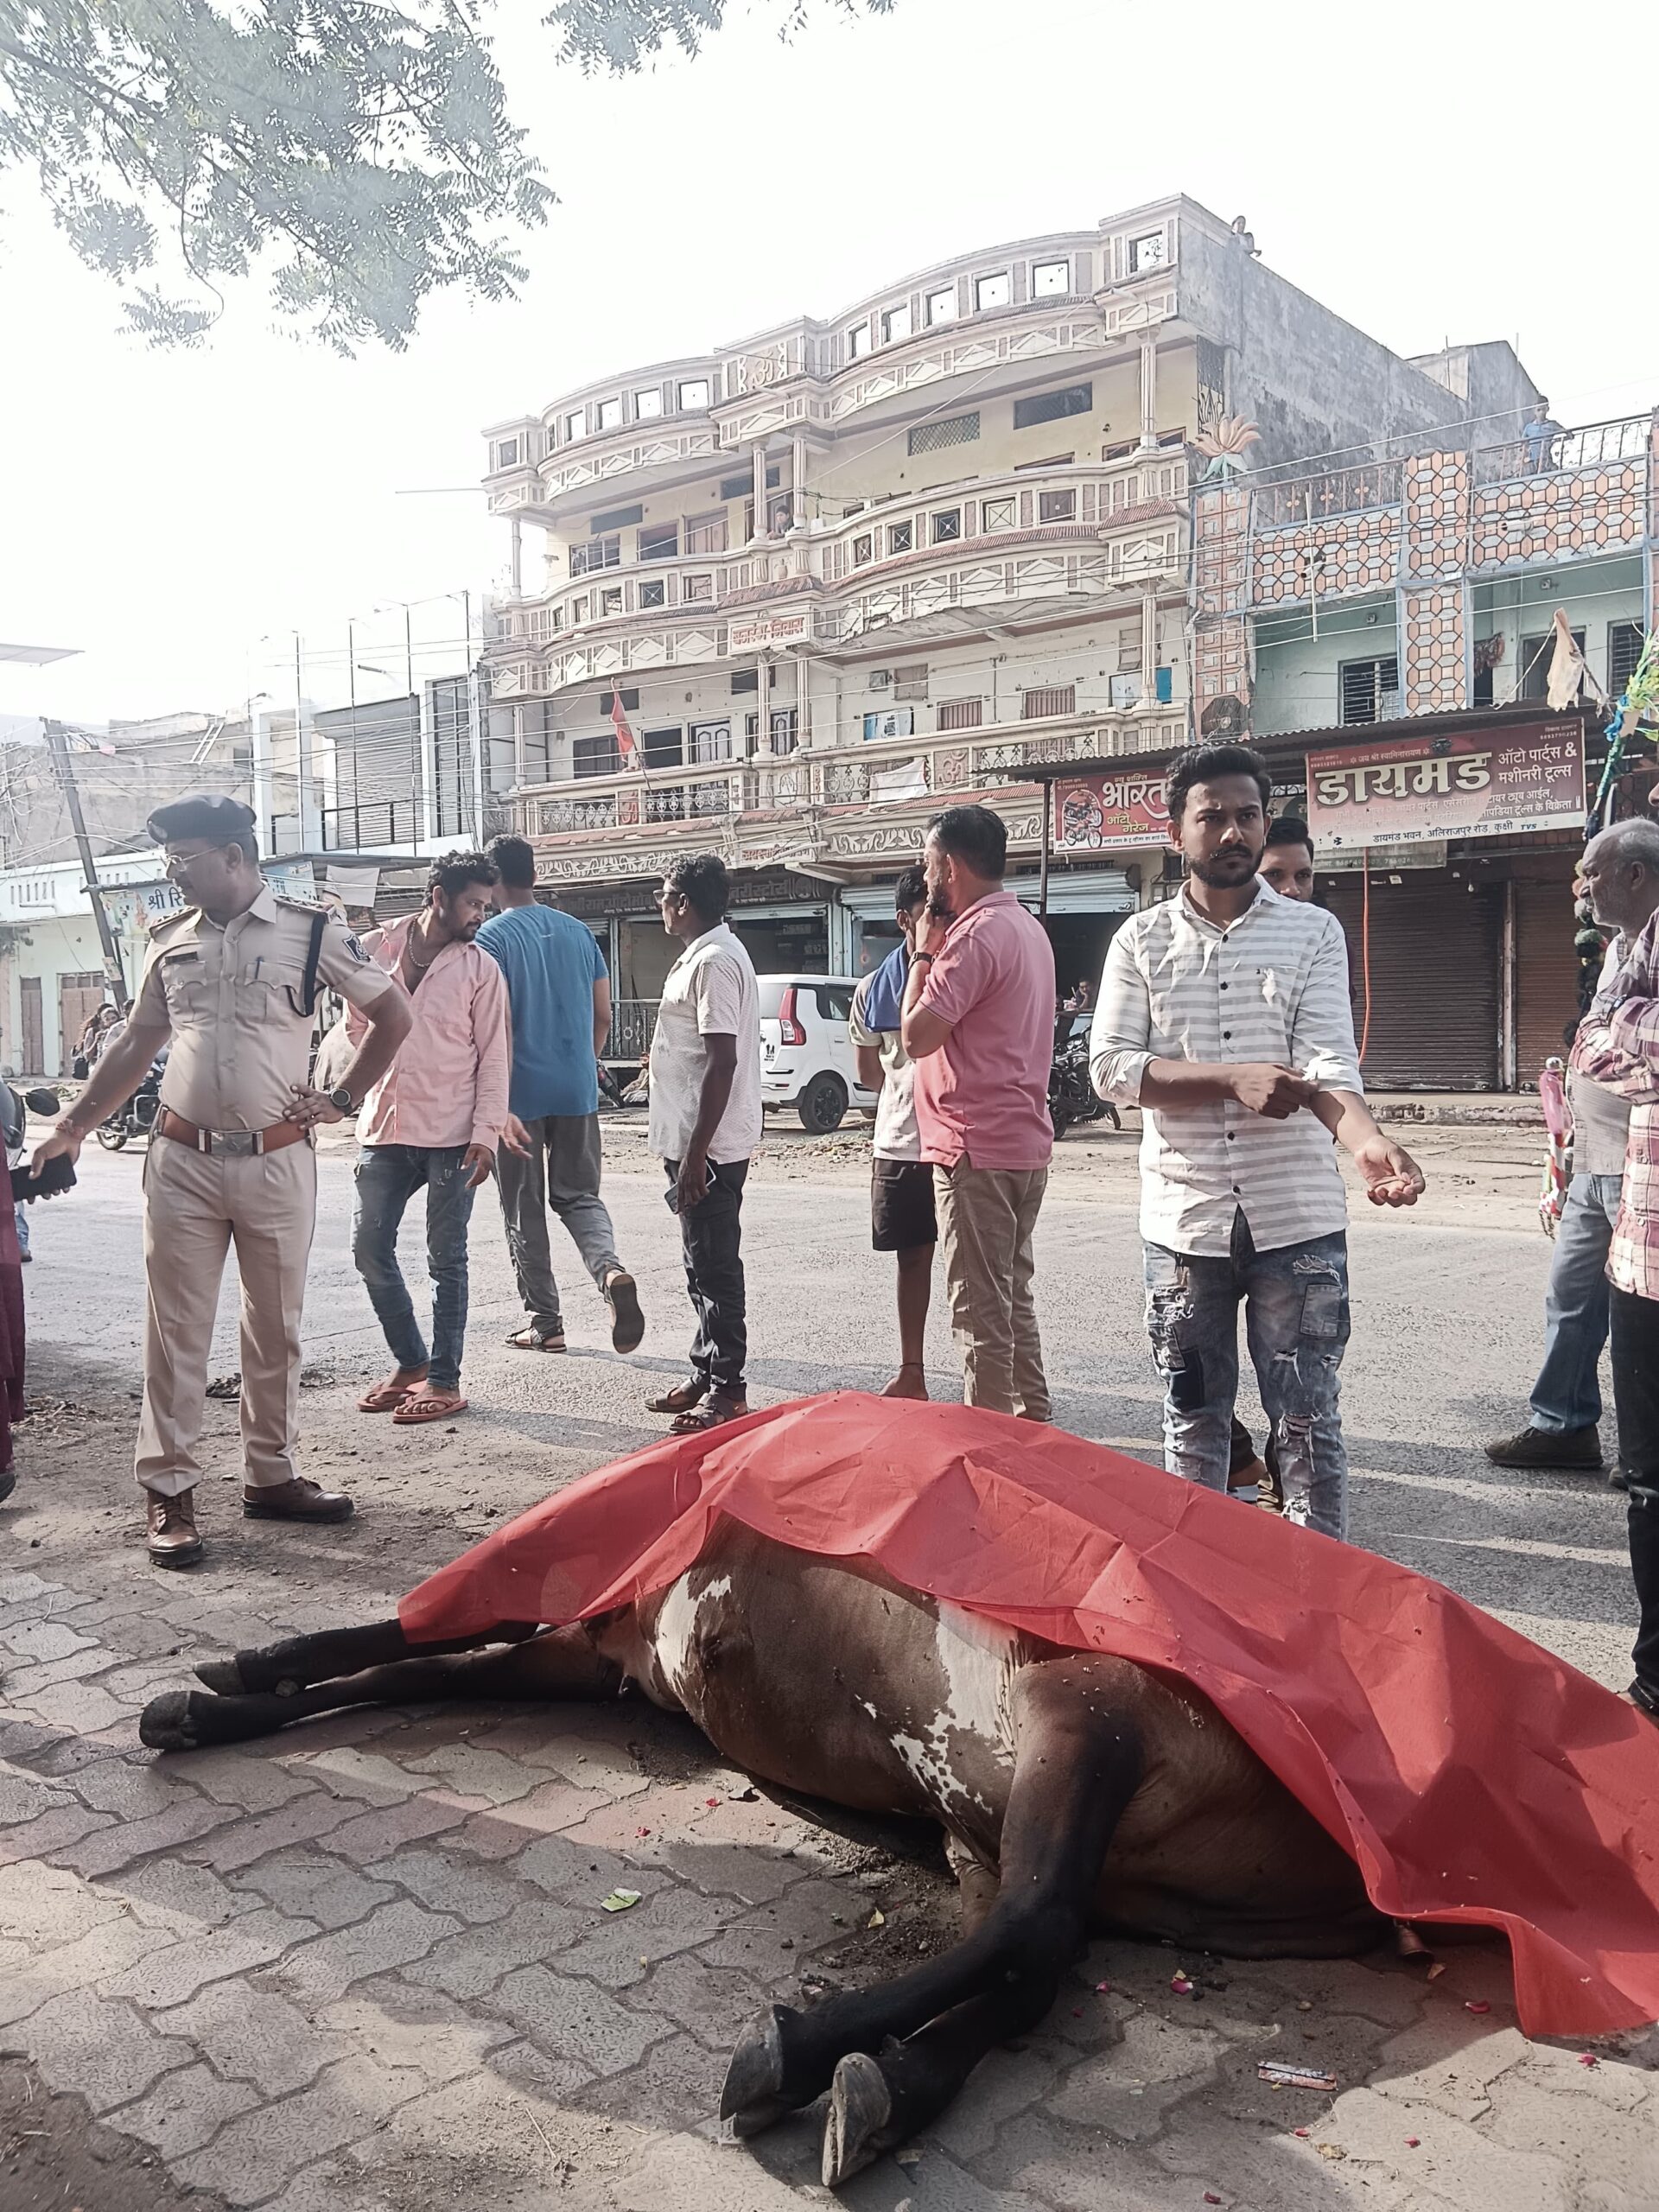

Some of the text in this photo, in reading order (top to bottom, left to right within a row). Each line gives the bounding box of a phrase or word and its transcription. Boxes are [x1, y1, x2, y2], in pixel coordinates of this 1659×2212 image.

[1498, 747, 1527, 765] ऑटो
[1564, 741, 1578, 758] &
[1498, 764, 1573, 784] मशीनरी टूल्स
[1102, 779, 1170, 819] भारत
[1514, 804, 1533, 817] टूल्स
[1535, 801, 1544, 811] के
[1545, 799, 1572, 810] विक्रेता
[1107, 812, 1129, 824] ऑटो
[1373, 831, 1402, 843] डायमंड
[1427, 825, 1471, 838] अलिराजपुर
[1494, 820, 1513, 835] कुक्षी
[148, 888, 166, 910] श्री
